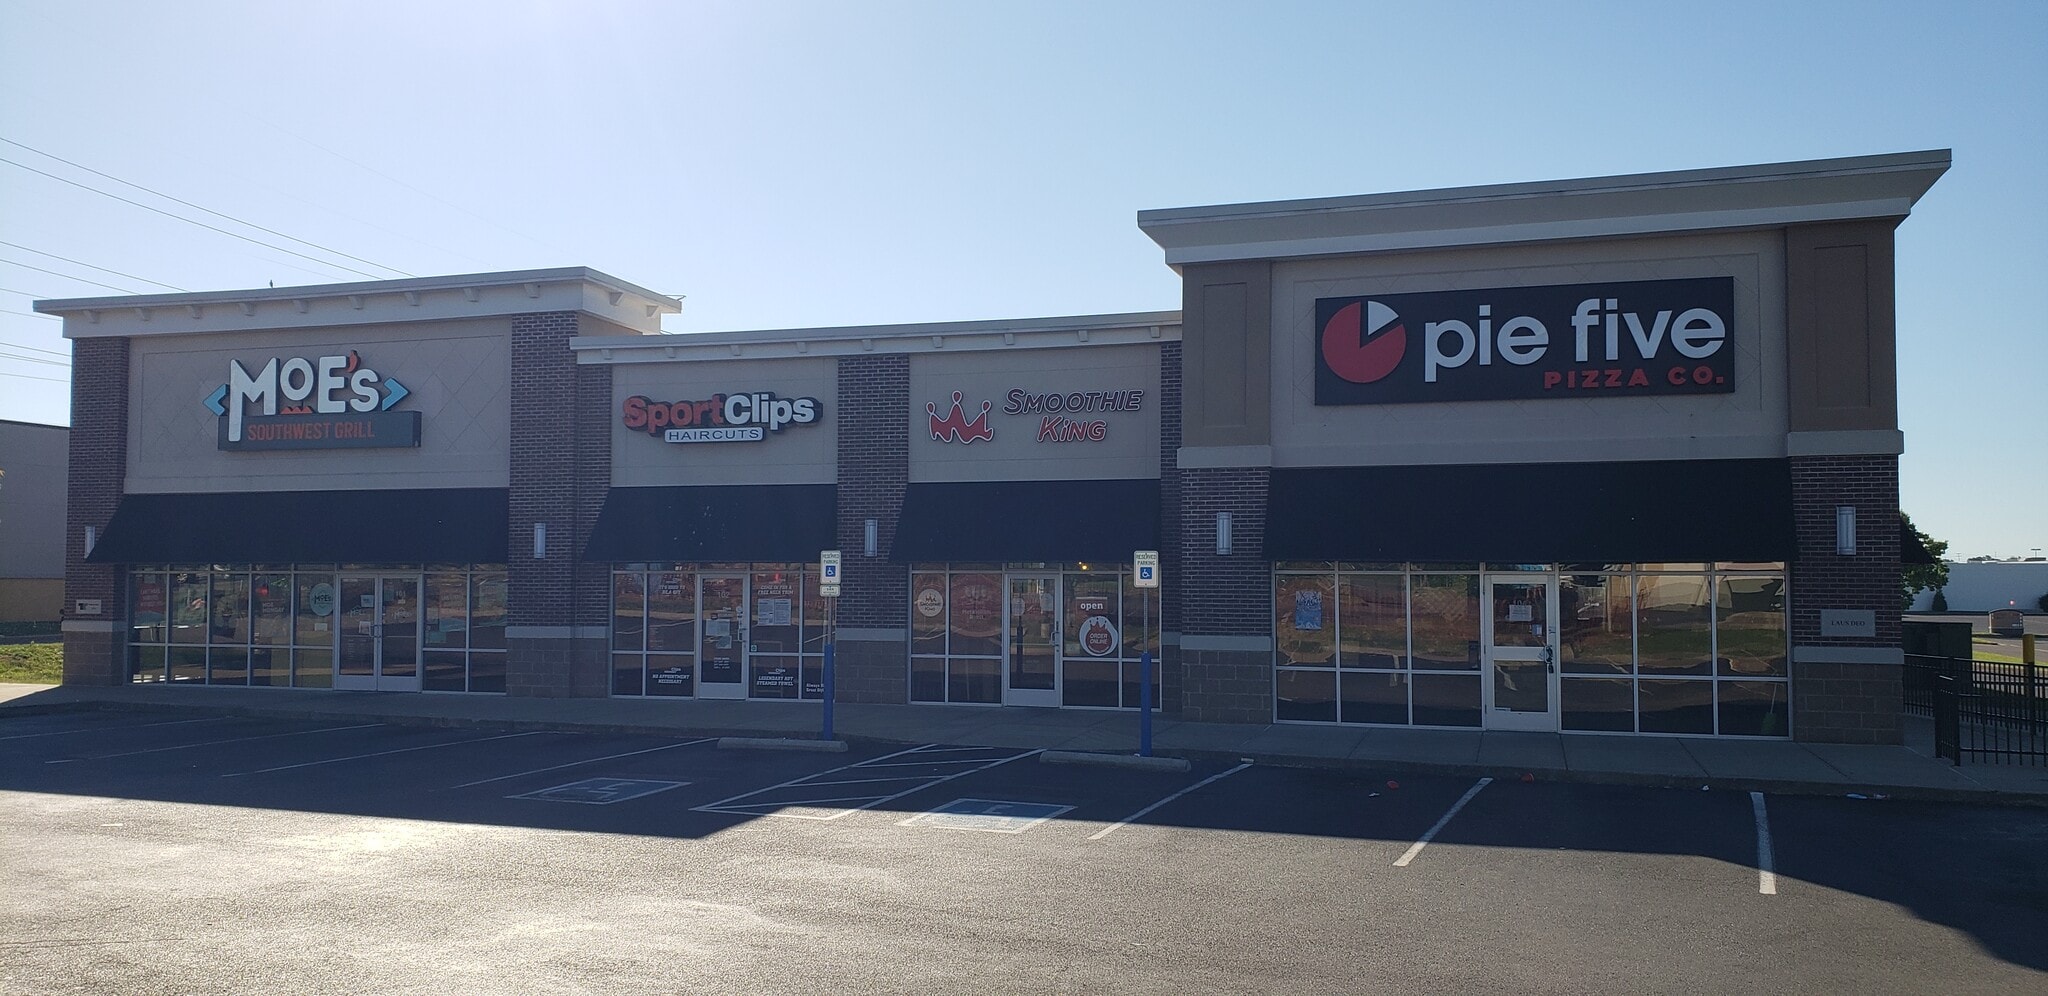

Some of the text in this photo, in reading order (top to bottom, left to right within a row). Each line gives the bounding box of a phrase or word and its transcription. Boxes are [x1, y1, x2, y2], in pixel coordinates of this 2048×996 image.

[1424, 298, 1726, 382] pie five
[1543, 365, 1724, 389] PIZZA CO.
[1002, 387, 1144, 415] SMOOTHIE
[247, 420, 376, 441] SOUTHWEST GRILL
[668, 428, 760, 441] HAIRCUTS
[1080, 602, 1104, 611] open
